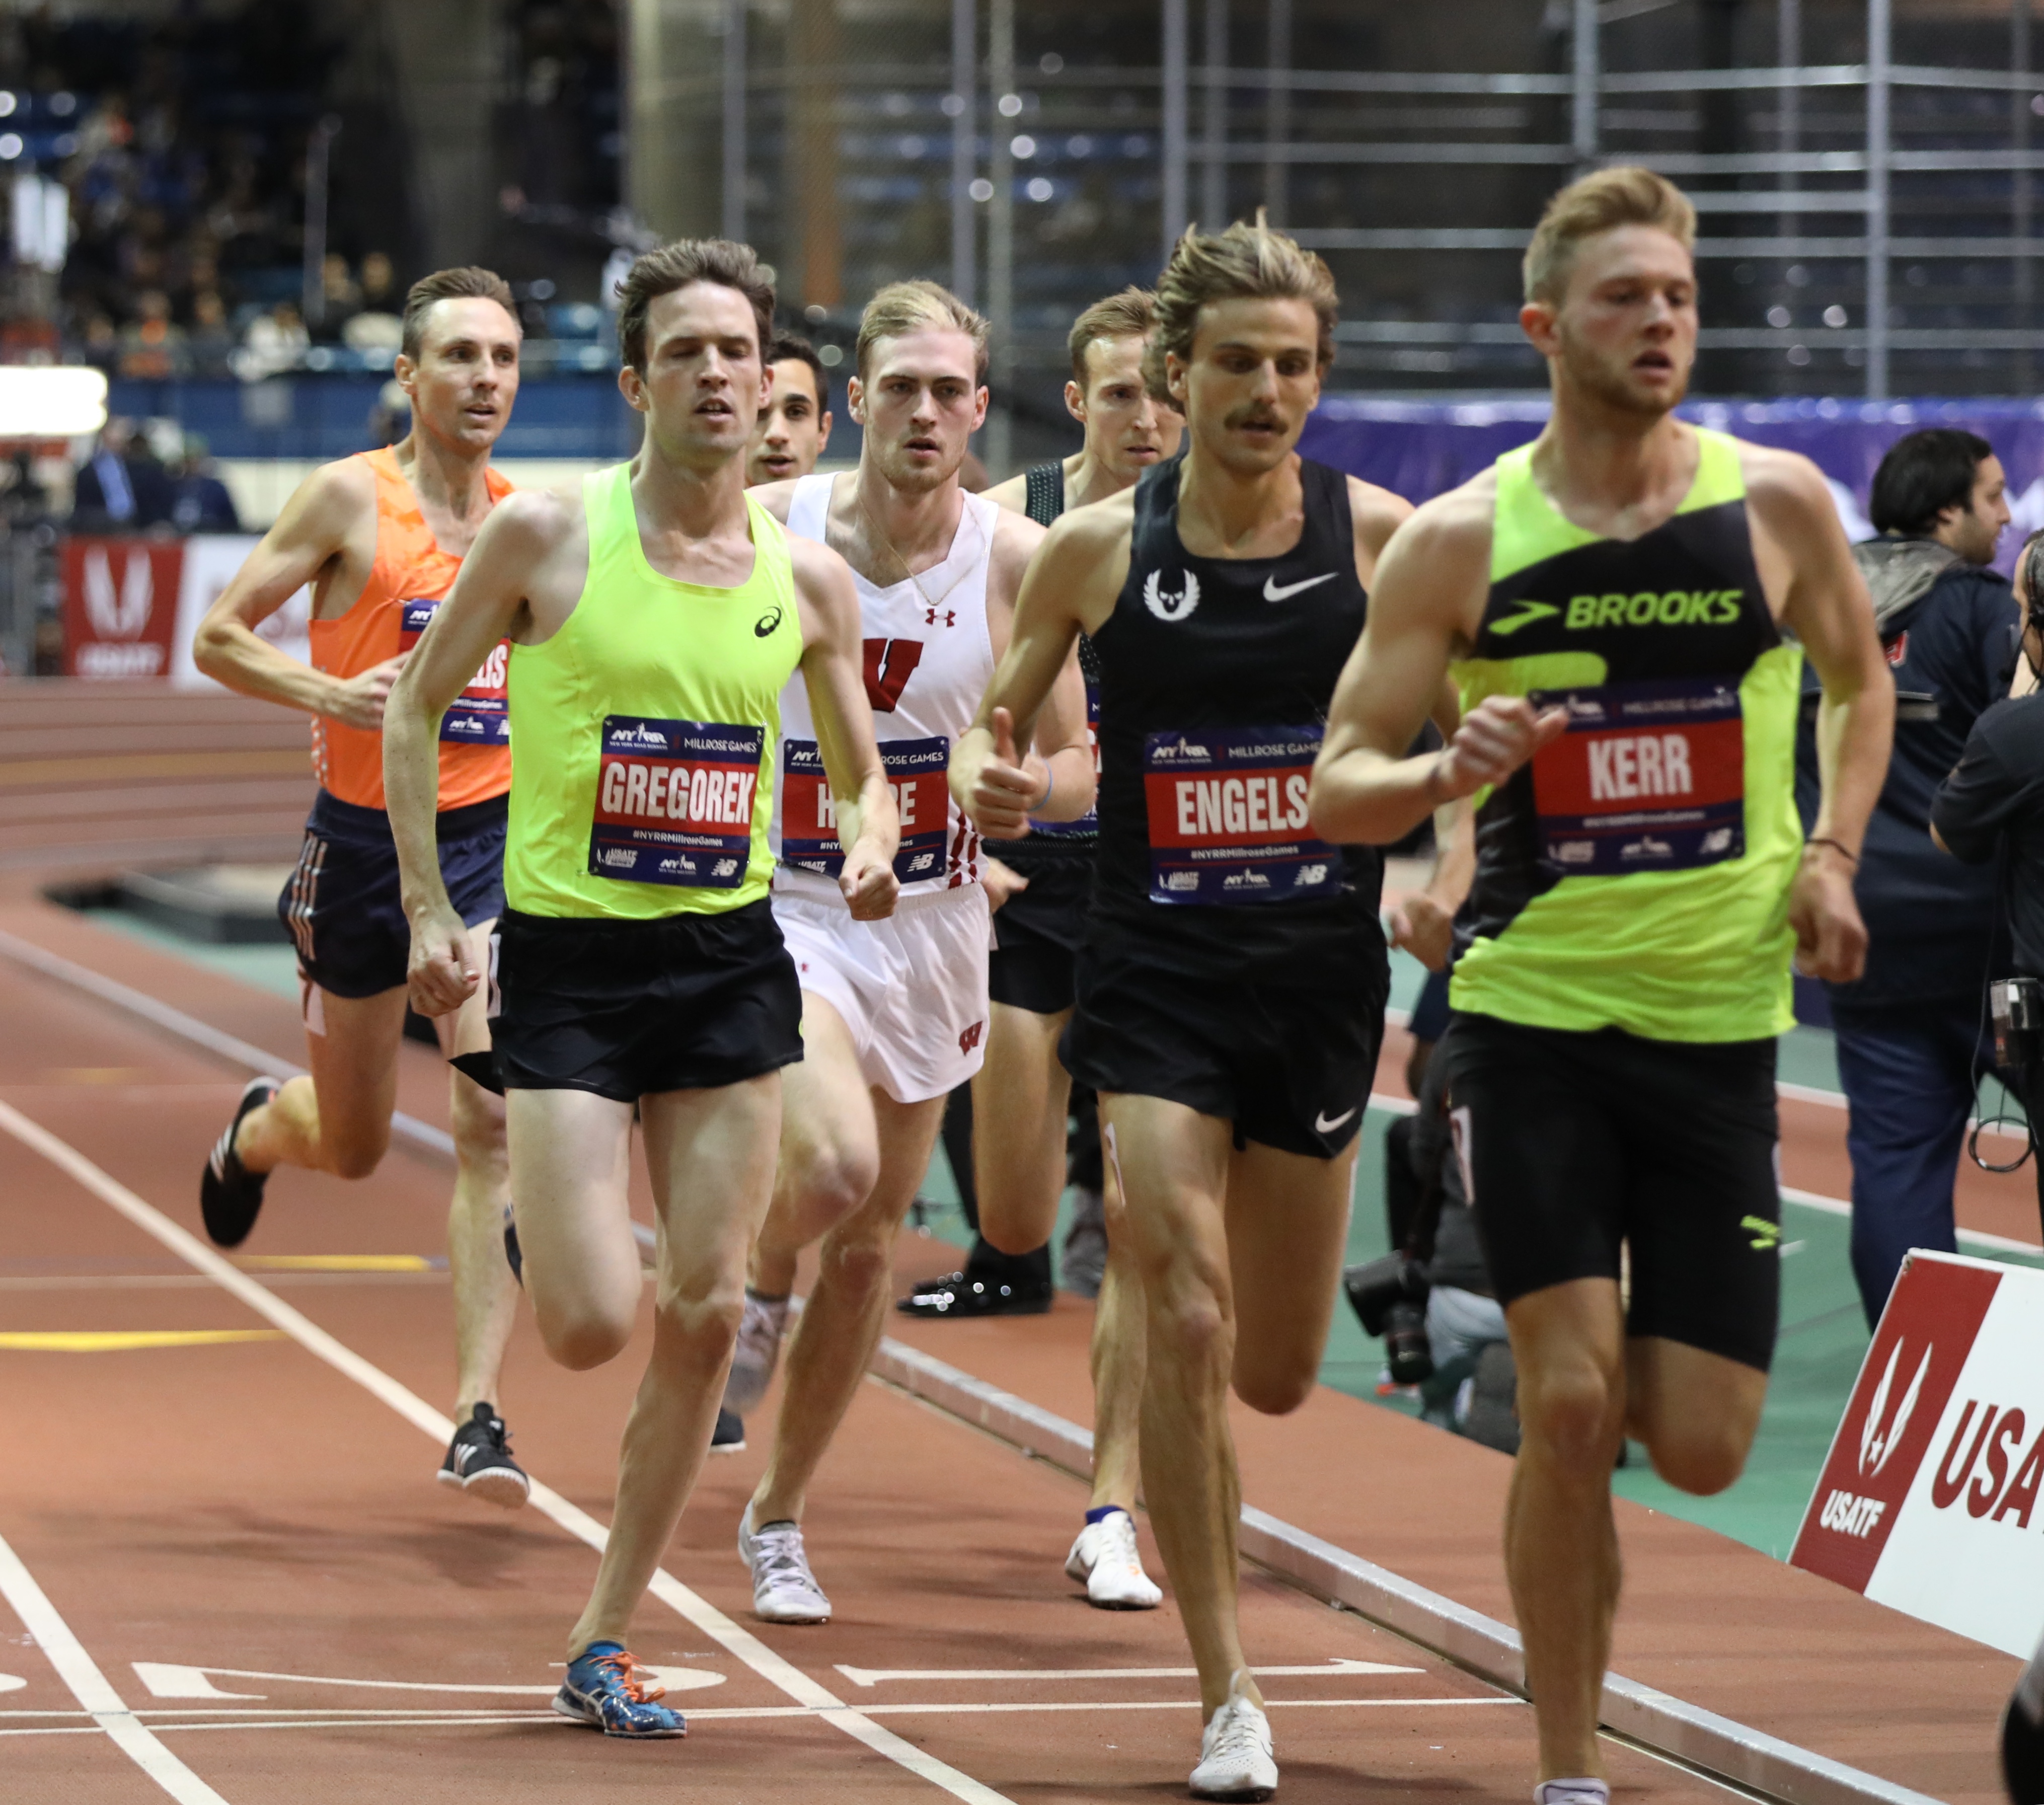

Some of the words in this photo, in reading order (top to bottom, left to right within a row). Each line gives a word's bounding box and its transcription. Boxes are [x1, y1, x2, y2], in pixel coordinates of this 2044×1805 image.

[1565, 589, 1743, 630] BROOKS
[684, 737, 728, 751] MILLROSE
[728, 740, 757, 753] GAMES
[909, 751, 944, 764] GAMES
[1228, 743, 1286, 759] MILLROSE
[1586, 733, 1694, 801] KERR
[602, 762, 755, 824] GREGOREK
[1175, 774, 1309, 836] ENGELS
[1931, 1399, 2044, 1529] USA
[1820, 1489, 1886, 1539] USATF
